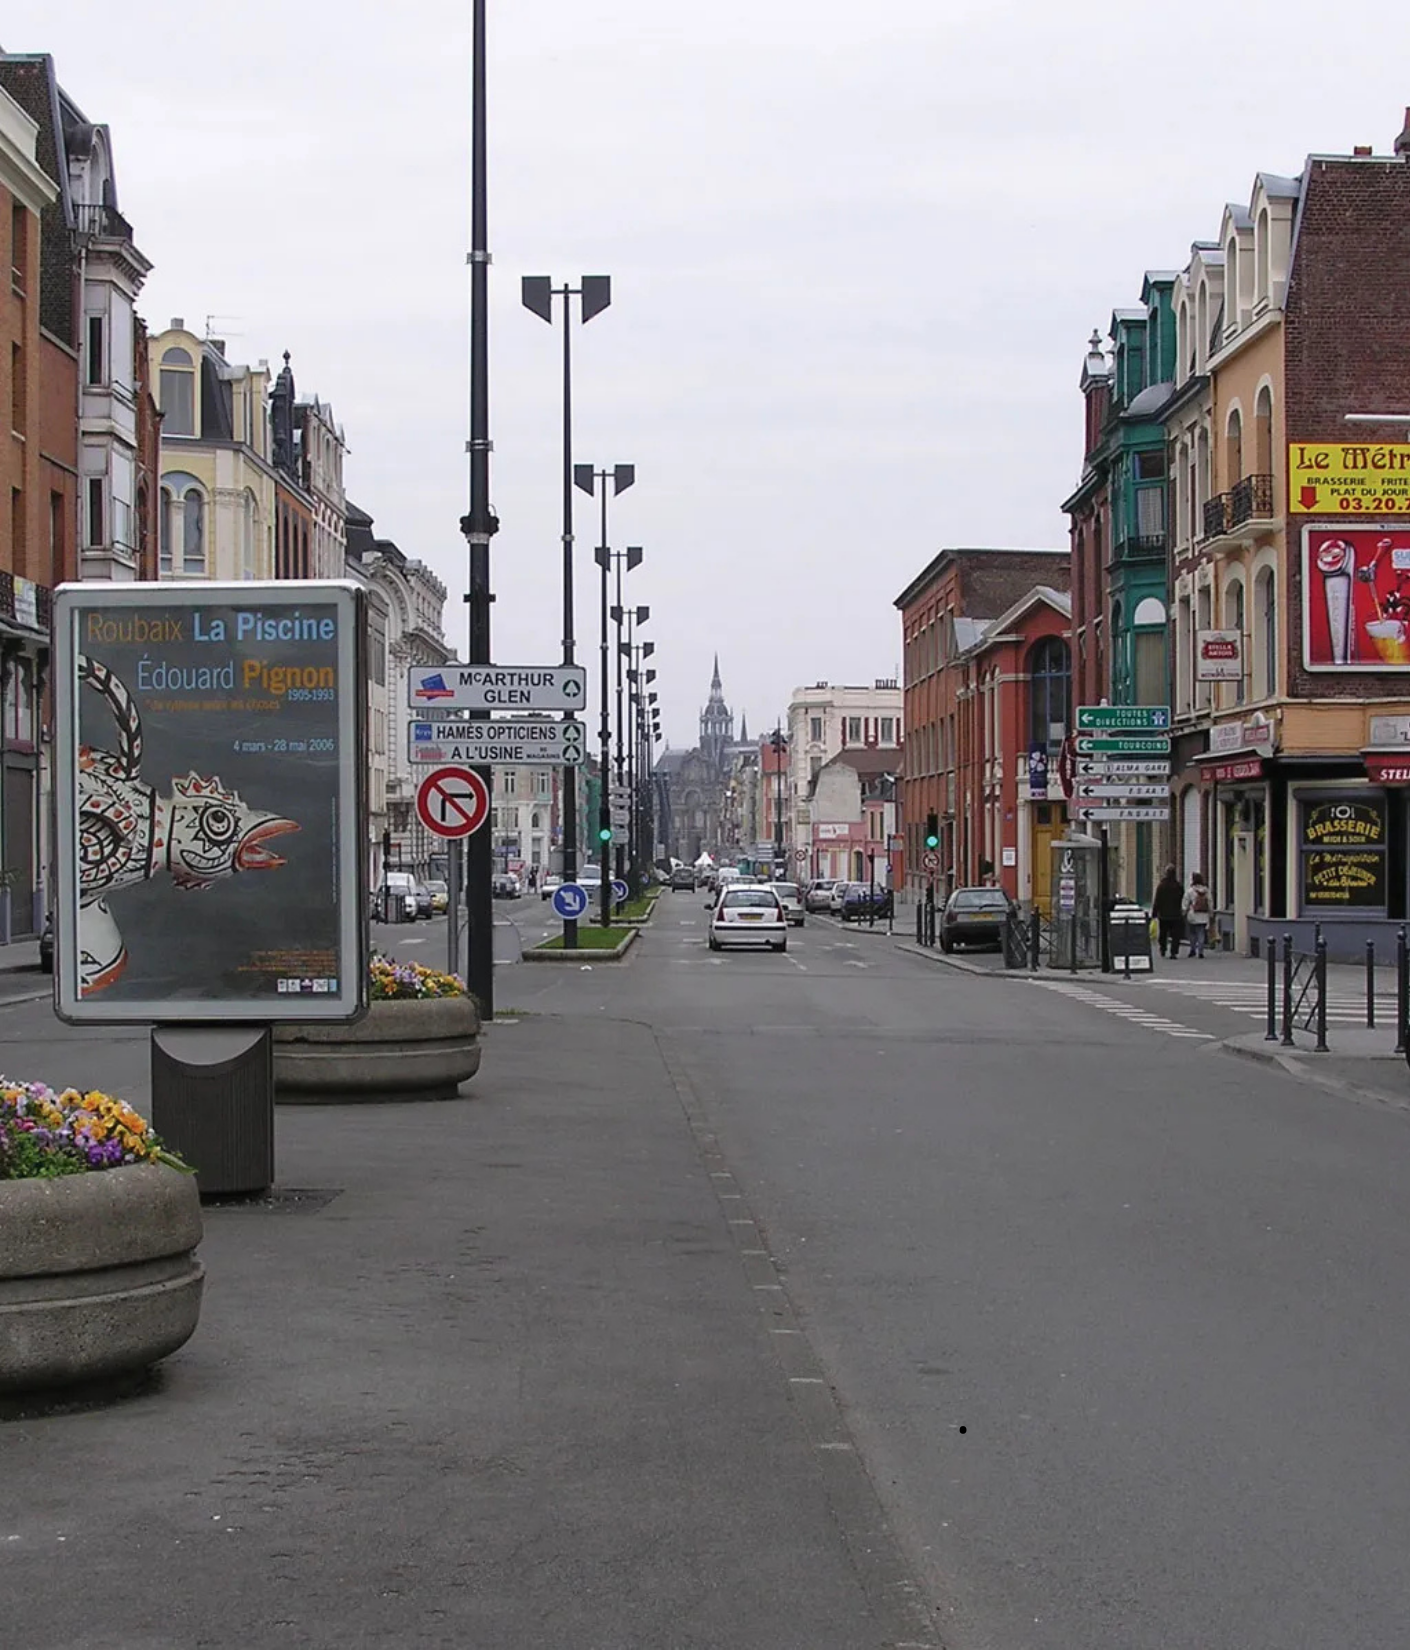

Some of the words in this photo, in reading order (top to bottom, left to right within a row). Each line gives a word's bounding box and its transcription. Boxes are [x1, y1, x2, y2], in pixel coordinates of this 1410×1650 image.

[1296, 447, 1330, 470] Le
[1306, 477, 1366, 486] BRASSERIE
[1330, 488, 1356, 496] PLAT
[1361, 488, 1377, 496] DU
[1381, 488, 1409, 496] JOUR
[87, 612, 184, 642] Roubaix
[194, 613, 225, 641] La
[237, 611, 335, 641] Piscine
[137, 653, 234, 690] Édouard
[242, 659, 334, 695] Pignon
[287, 689, 334, 700] 1905-1993
[484, 689, 531, 704] GLEN
[1095, 718, 1148, 726] DIRECTIONS
[487, 726, 557, 740] OPTICIENS
[233, 740, 240, 751] 4
[242, 742, 265, 751] mars
[274, 739, 287, 751] 28
[289, 740, 307, 751] mai
[309, 739, 334, 751] 2006
[451, 746, 462, 760] A
[466, 746, 524, 760] L'USINE
[1306, 820, 1381, 840] BRASSERIE
